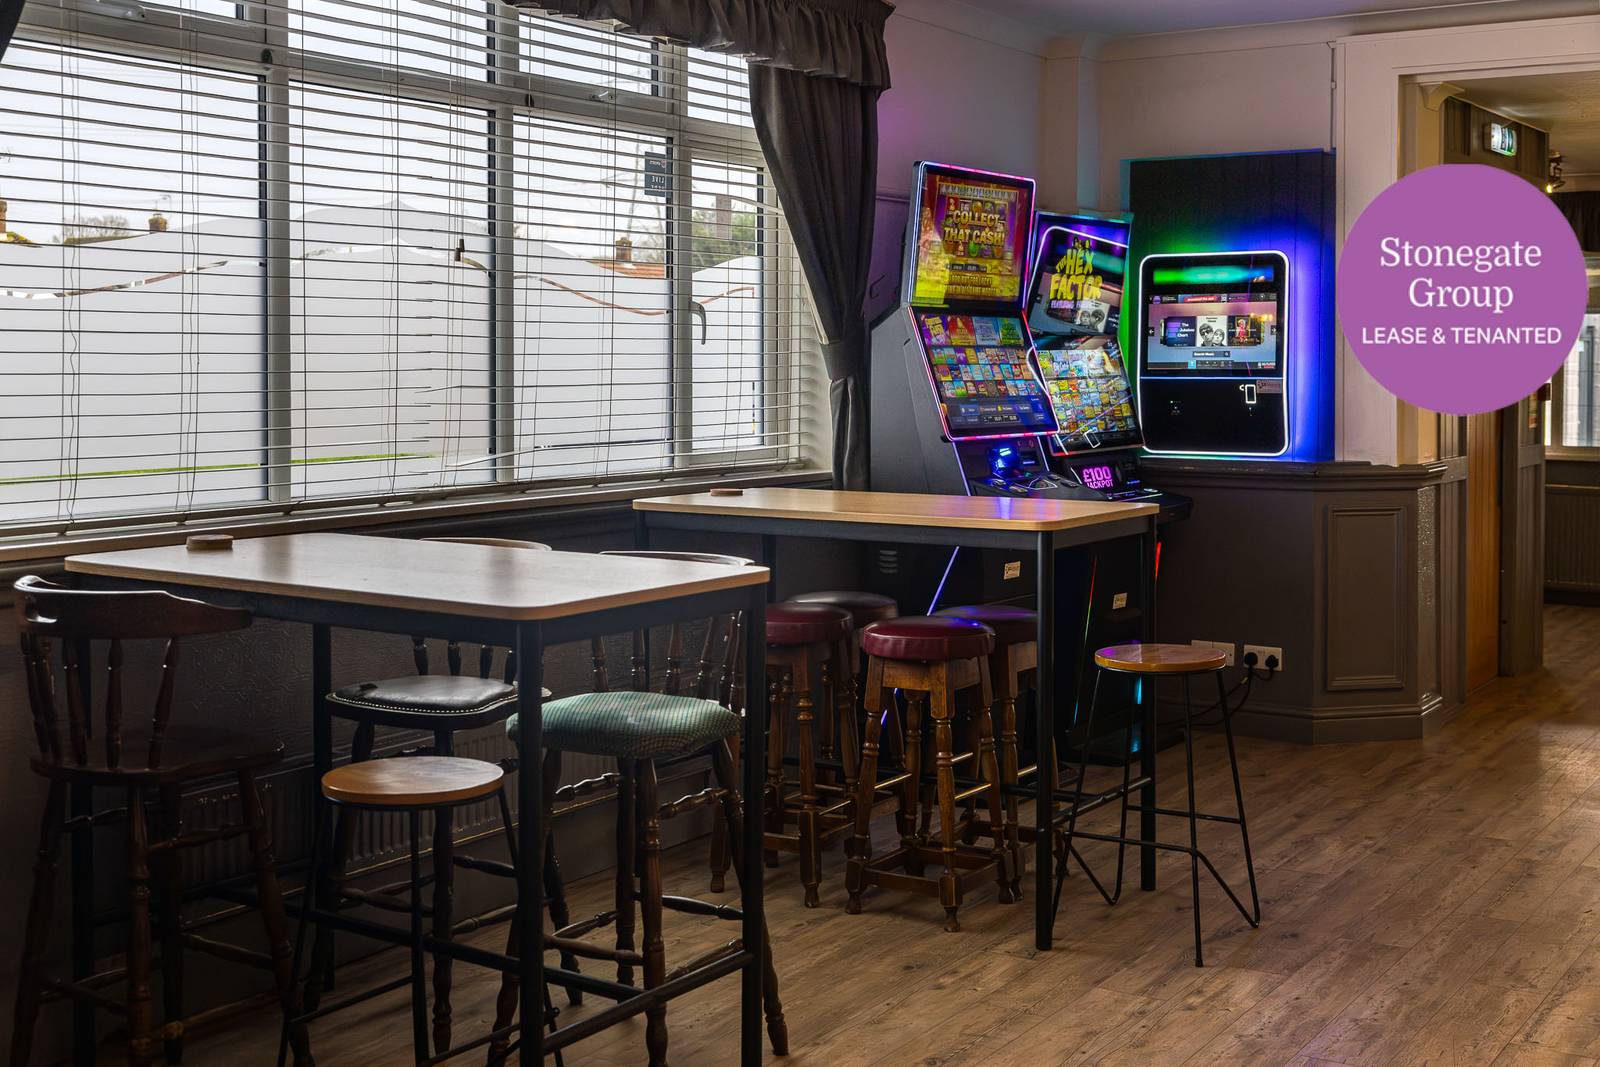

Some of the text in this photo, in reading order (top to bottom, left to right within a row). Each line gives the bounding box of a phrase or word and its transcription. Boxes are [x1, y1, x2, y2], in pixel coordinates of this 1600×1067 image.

[953, 211, 1000, 227] COLLECT
[944, 227, 1005, 245] THAT CASH!
[1066, 248, 1094, 275] HEX
[1049, 273, 1103, 300] FACTOR
[1083, 466, 1112, 482] £100
[1087, 479, 1113, 488] JACKPOT
